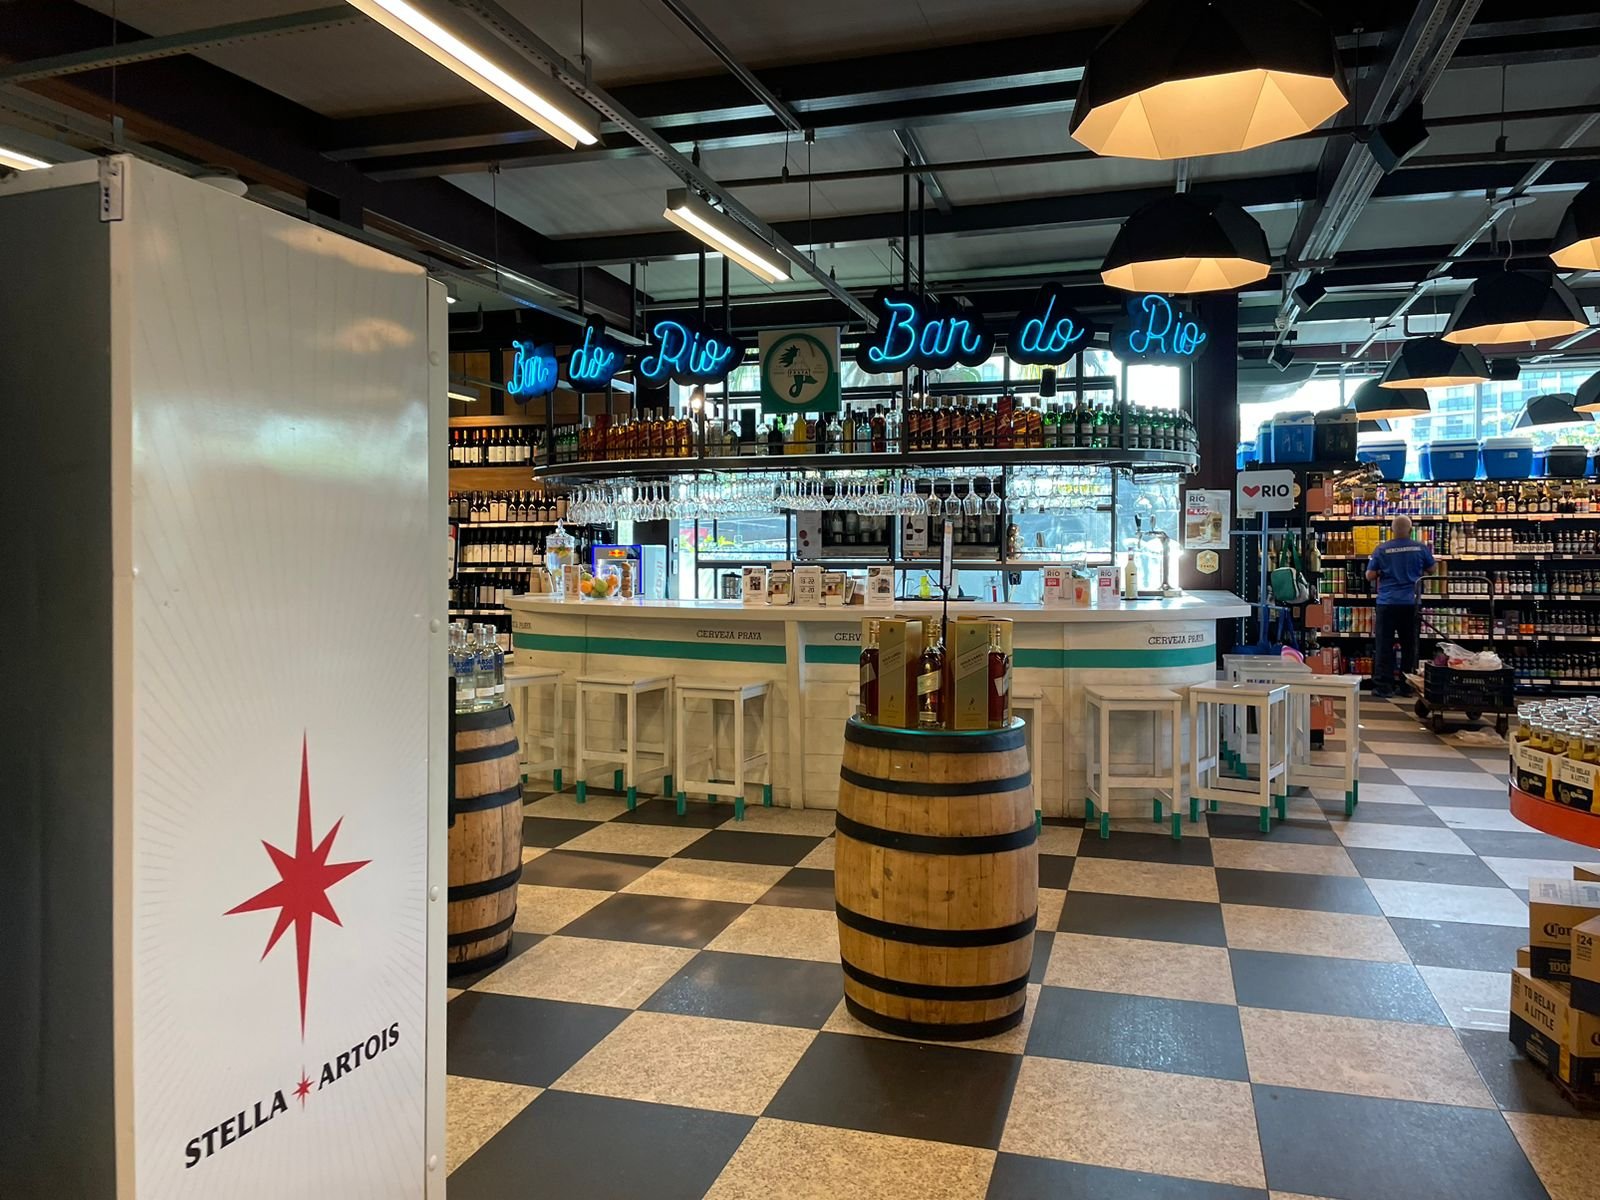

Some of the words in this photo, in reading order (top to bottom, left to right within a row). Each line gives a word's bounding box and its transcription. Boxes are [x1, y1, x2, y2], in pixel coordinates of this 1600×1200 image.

[868, 297, 981, 362] Bar
[1020, 294, 1085, 352] do
[1129, 294, 1206, 355] Rio
[569, 326, 615, 379] do
[640, 320, 732, 378] Rio
[1261, 484, 1290, 498] RIO
[1189, 495, 1206, 503] RIO
[696, 629, 735, 640] CERVEJA
[737, 631, 762, 640] PRAYA
[834, 632, 862, 641] CERV
[1147, 635, 1186, 645] CERVEJA
[1543, 922, 1572, 938] Cor
[1580, 935, 1593, 946] 24
[1548, 962, 1571, 973] 100
[1523, 984, 1533, 1000] TO
[1533, 991, 1556, 1015] RELAX
[1524, 1002, 1530, 1014] A
[1530, 1006, 1555, 1032] LITTLE
[184, 1089, 288, 1170] STELLA
[317, 1021, 400, 1091] ARTOIS
